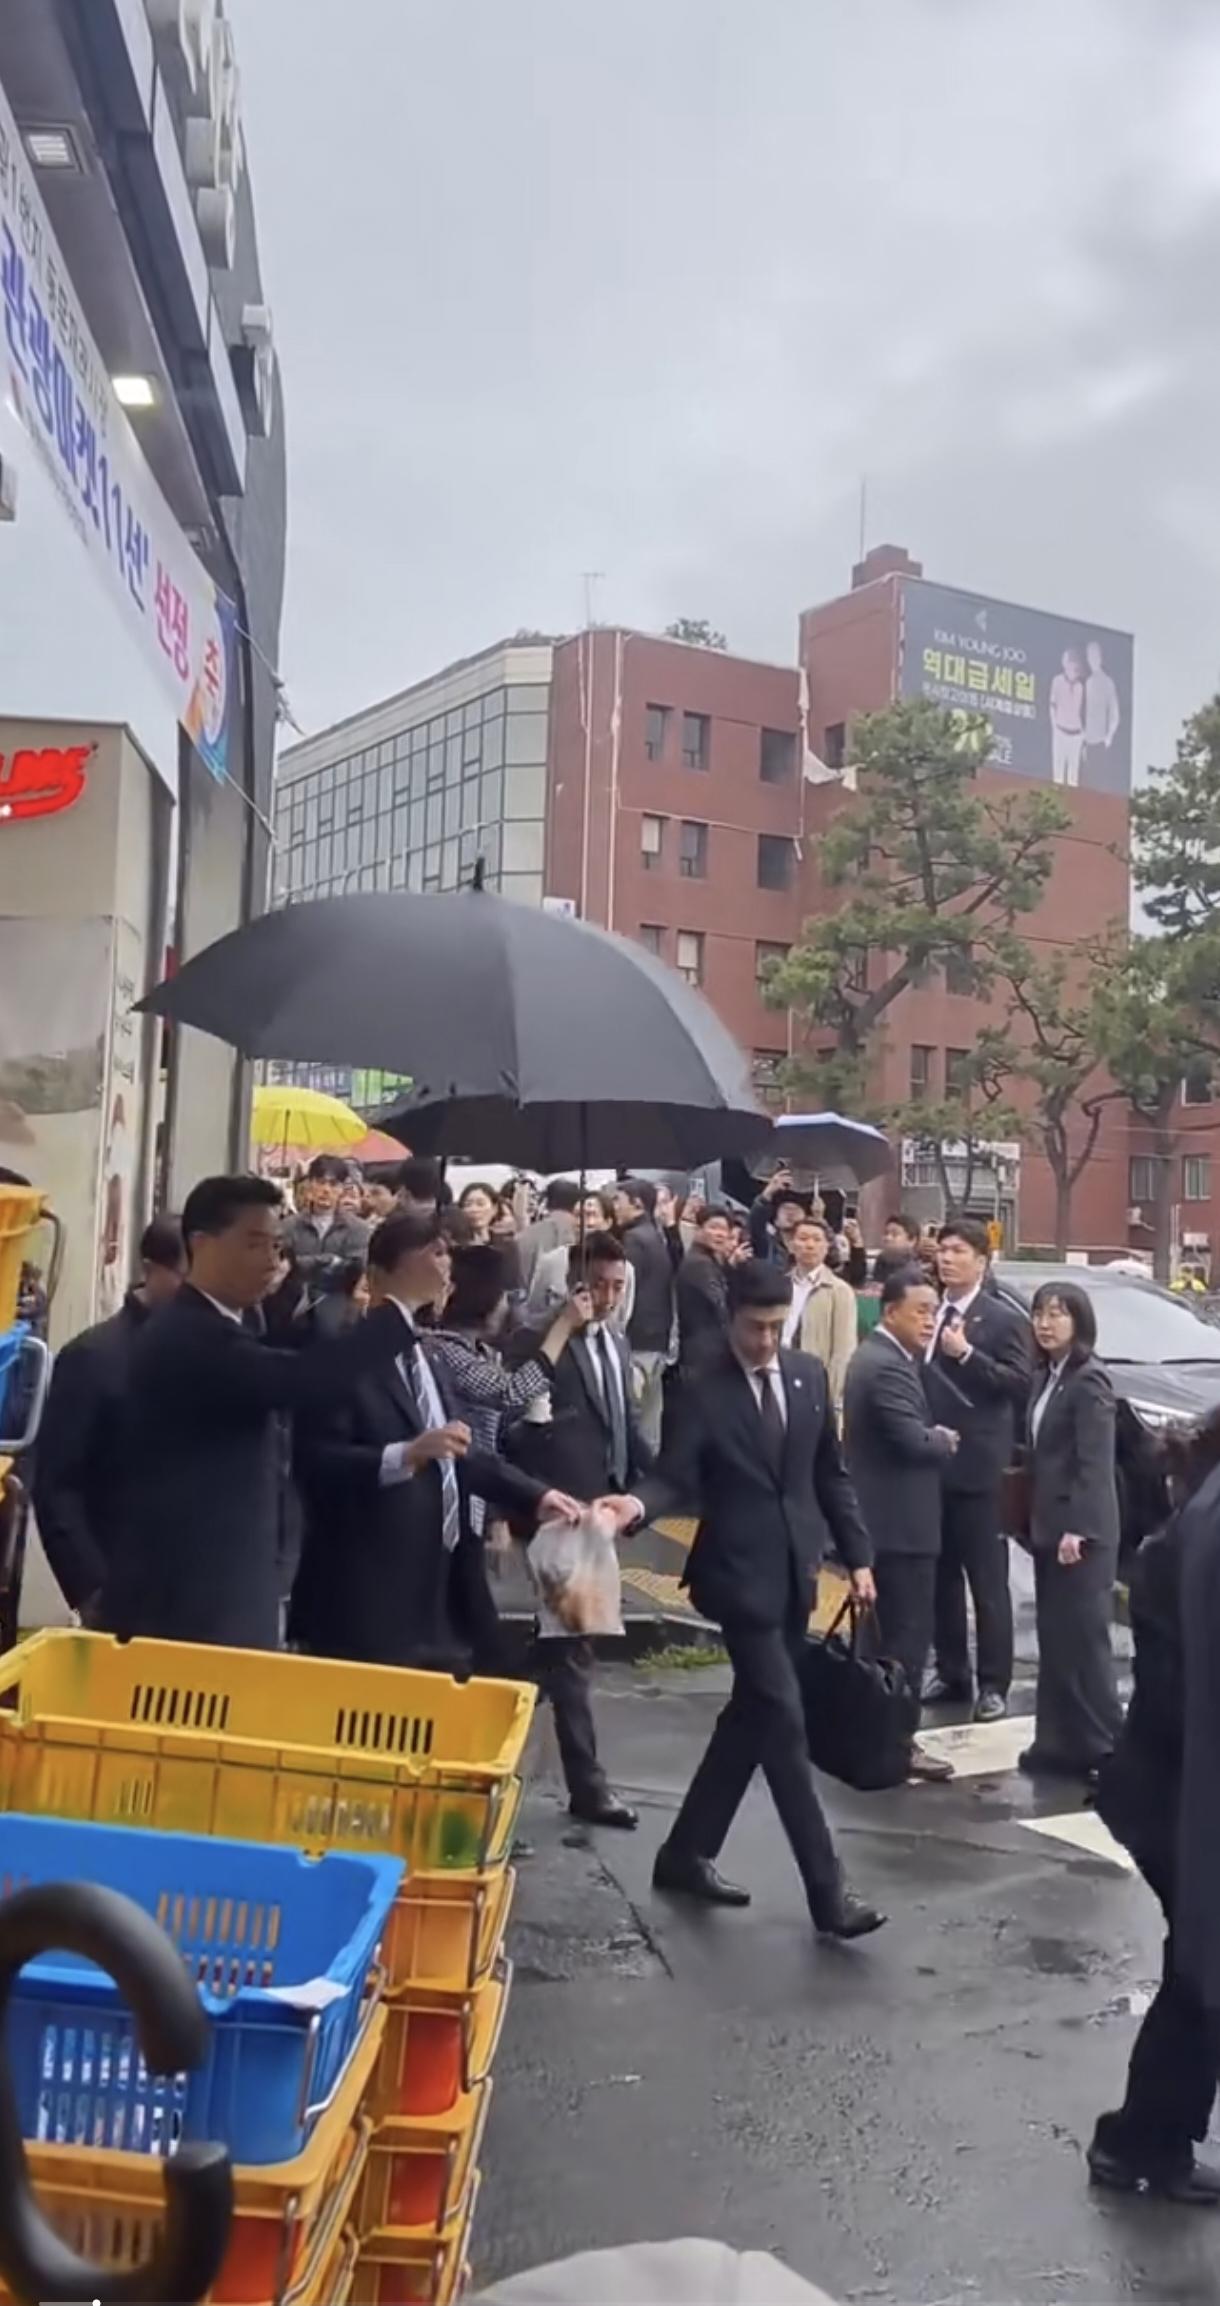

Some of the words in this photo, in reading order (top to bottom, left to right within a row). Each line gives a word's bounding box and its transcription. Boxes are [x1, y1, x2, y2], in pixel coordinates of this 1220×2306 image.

[154, 560, 190, 683] 선정
[933, 628, 956, 646] KIM
[957, 634, 1001, 658] YOUNG
[1002, 646, 1026, 663] JOO
[922, 647, 1035, 701] 역대급세일
